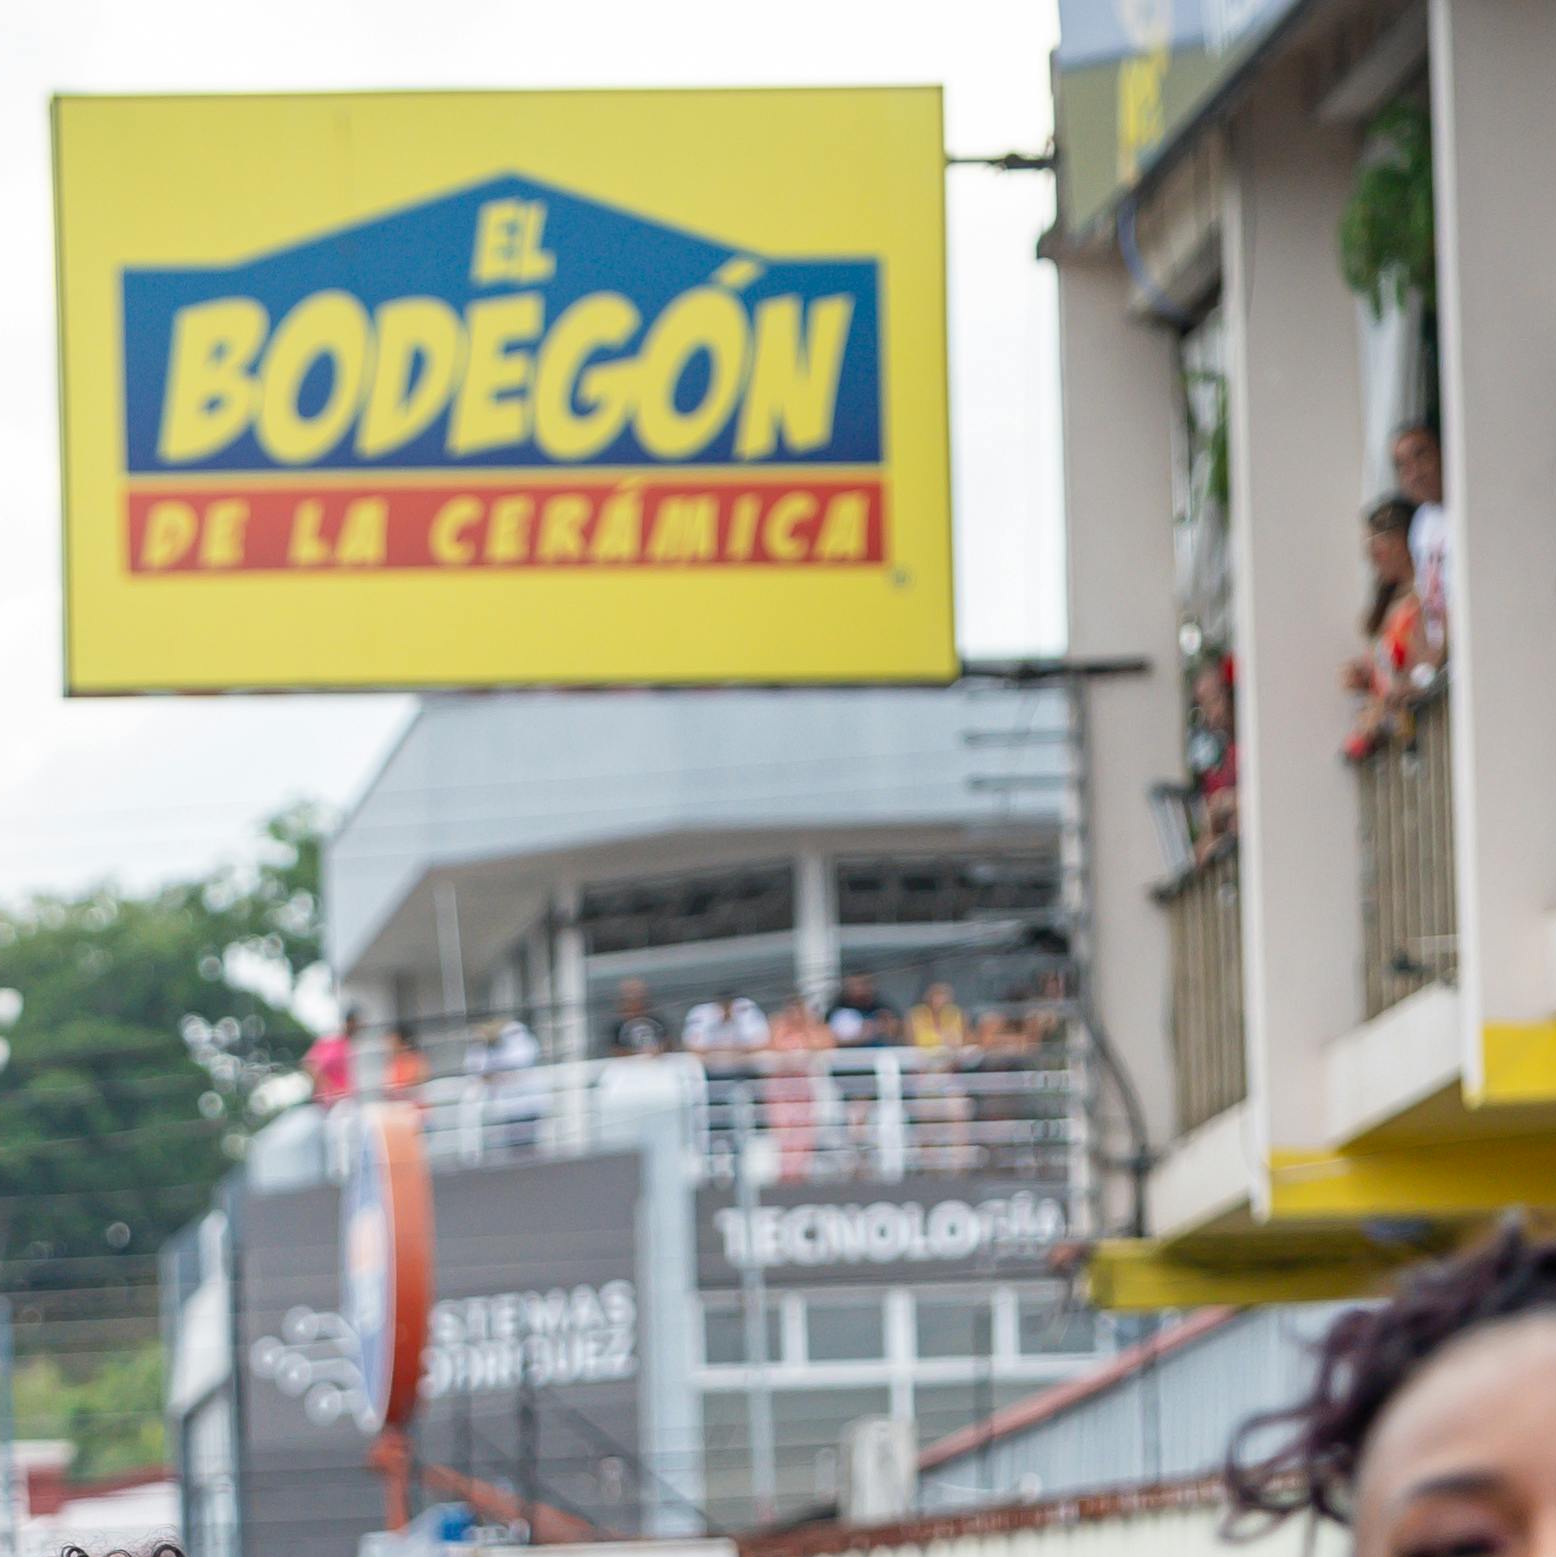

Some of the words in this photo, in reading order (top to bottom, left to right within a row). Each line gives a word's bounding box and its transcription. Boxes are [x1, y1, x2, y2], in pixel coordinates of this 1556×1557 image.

[474, 197, 556, 283] EL
[158, 252, 854, 464] BODEGÓN
[139, 498, 251, 568] DE
[286, 496, 388, 568] LA
[428, 478, 870, 565] CERÁMICA
[428, 1279, 638, 1346] STEMAS
